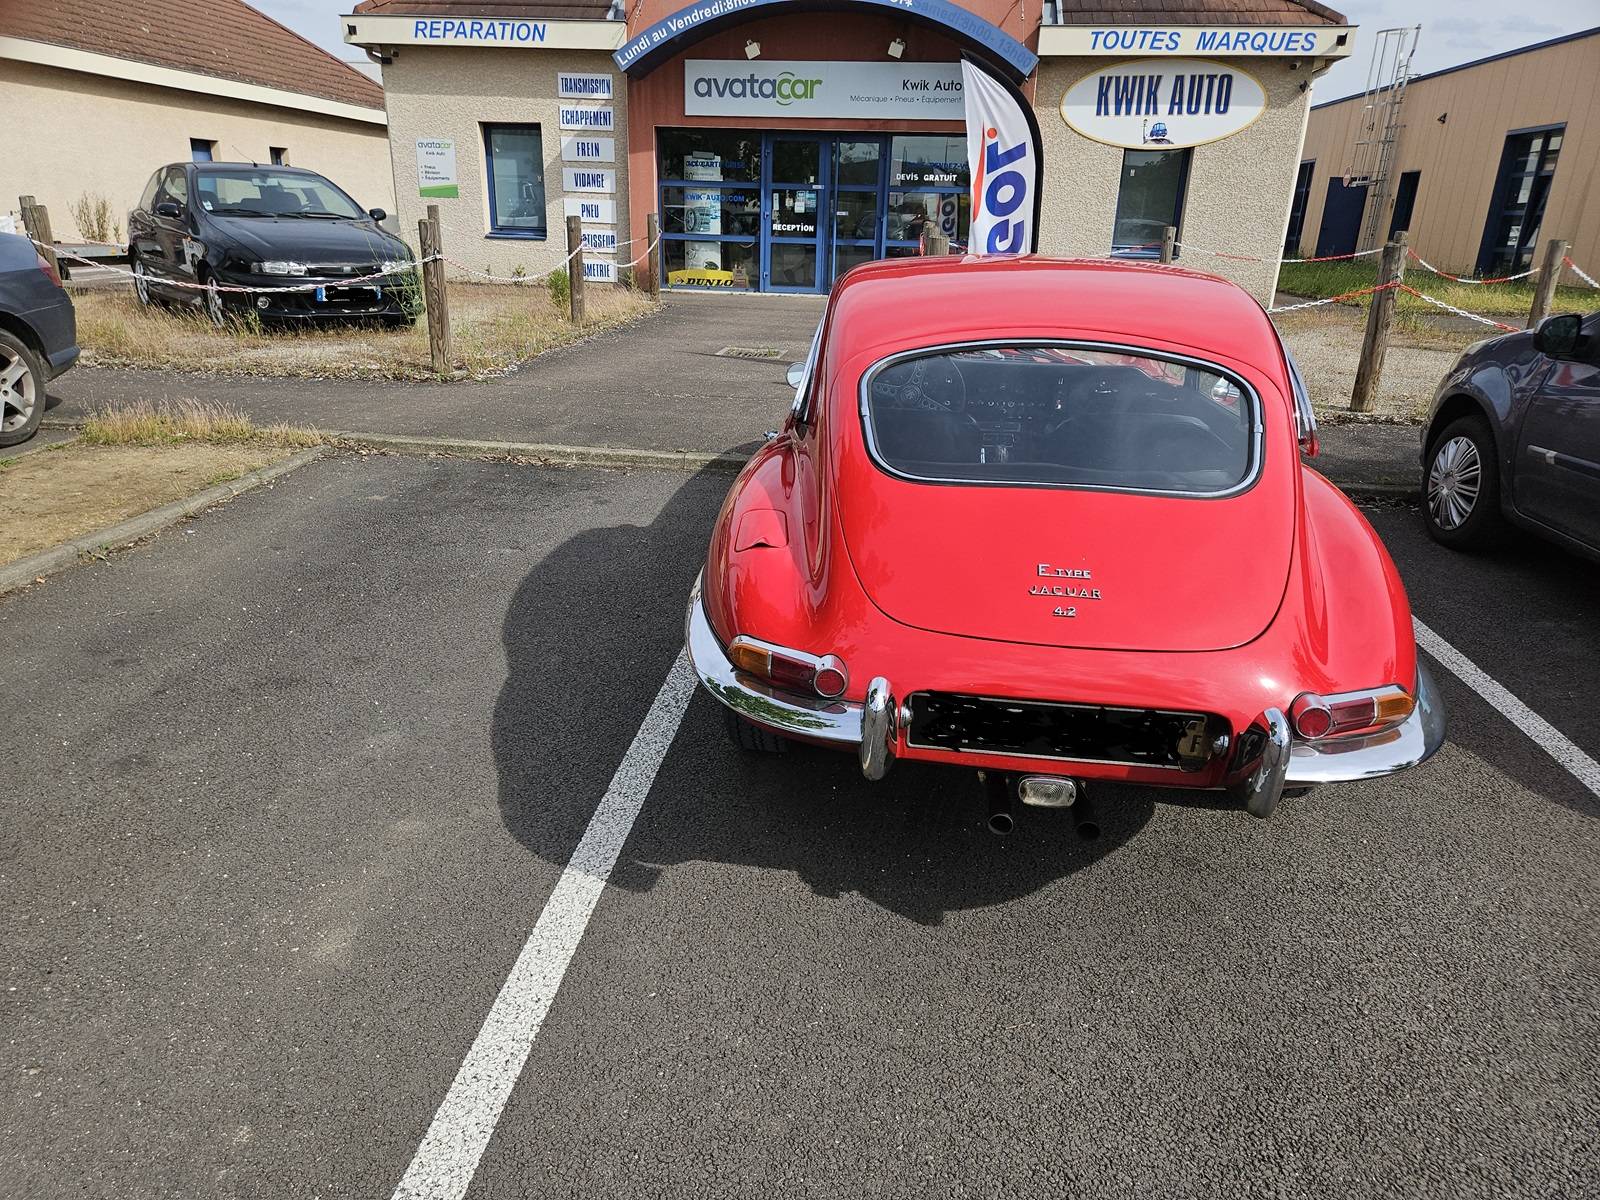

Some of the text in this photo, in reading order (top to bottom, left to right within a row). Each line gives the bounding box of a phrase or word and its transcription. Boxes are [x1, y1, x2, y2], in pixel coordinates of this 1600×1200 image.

[414, 20, 546, 41] REPARATION
[617, 35, 651, 66] Lundi
[652, 28, 667, 43] au
[1090, 30, 1317, 52] TOUTES MARQUES
[561, 77, 611, 94] TRANSMISSION
[694, 73, 823, 101] avatacar
[902, 79, 962, 91] Kwik Auto
[895, 95, 915, 103] Pneus
[1095, 74, 1234, 116] KWIK AUTO
[561, 110, 611, 126] ECHAPPEMENT
[576, 142, 600, 157] FREIN
[574, 173, 605, 188] VIDANGE
[581, 203, 600, 218] PNEU
[686, 277, 734, 287] DUNLO
[1037, 563, 1091, 579] E TYPE
[1028, 585, 1102, 600] JAGUAR
[1053, 606, 1076, 618] 4.2
